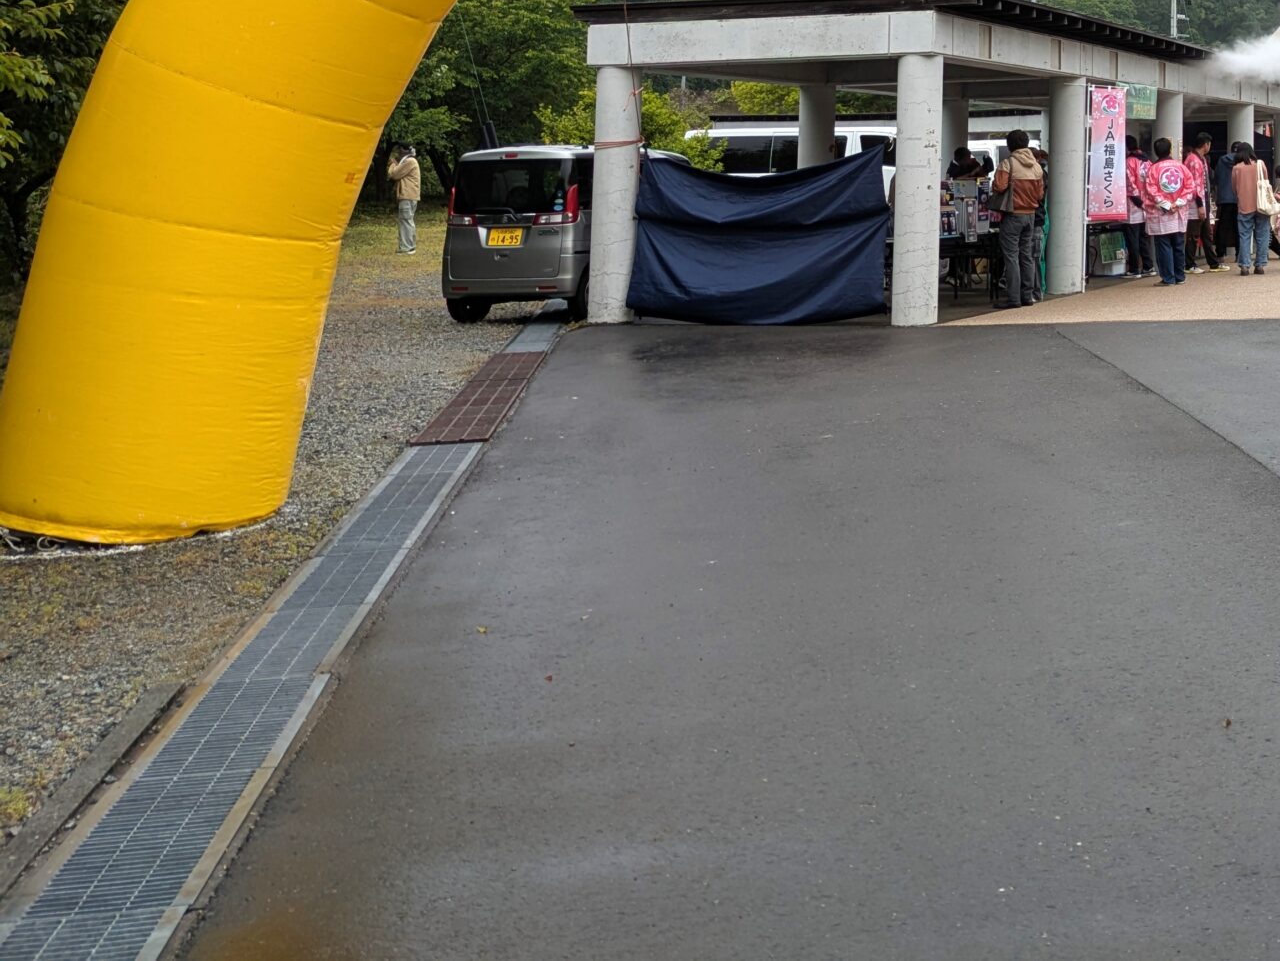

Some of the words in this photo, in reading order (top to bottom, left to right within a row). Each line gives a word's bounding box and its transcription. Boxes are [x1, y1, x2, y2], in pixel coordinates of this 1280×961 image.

[1103, 118, 1116, 209] JA福島さくら
